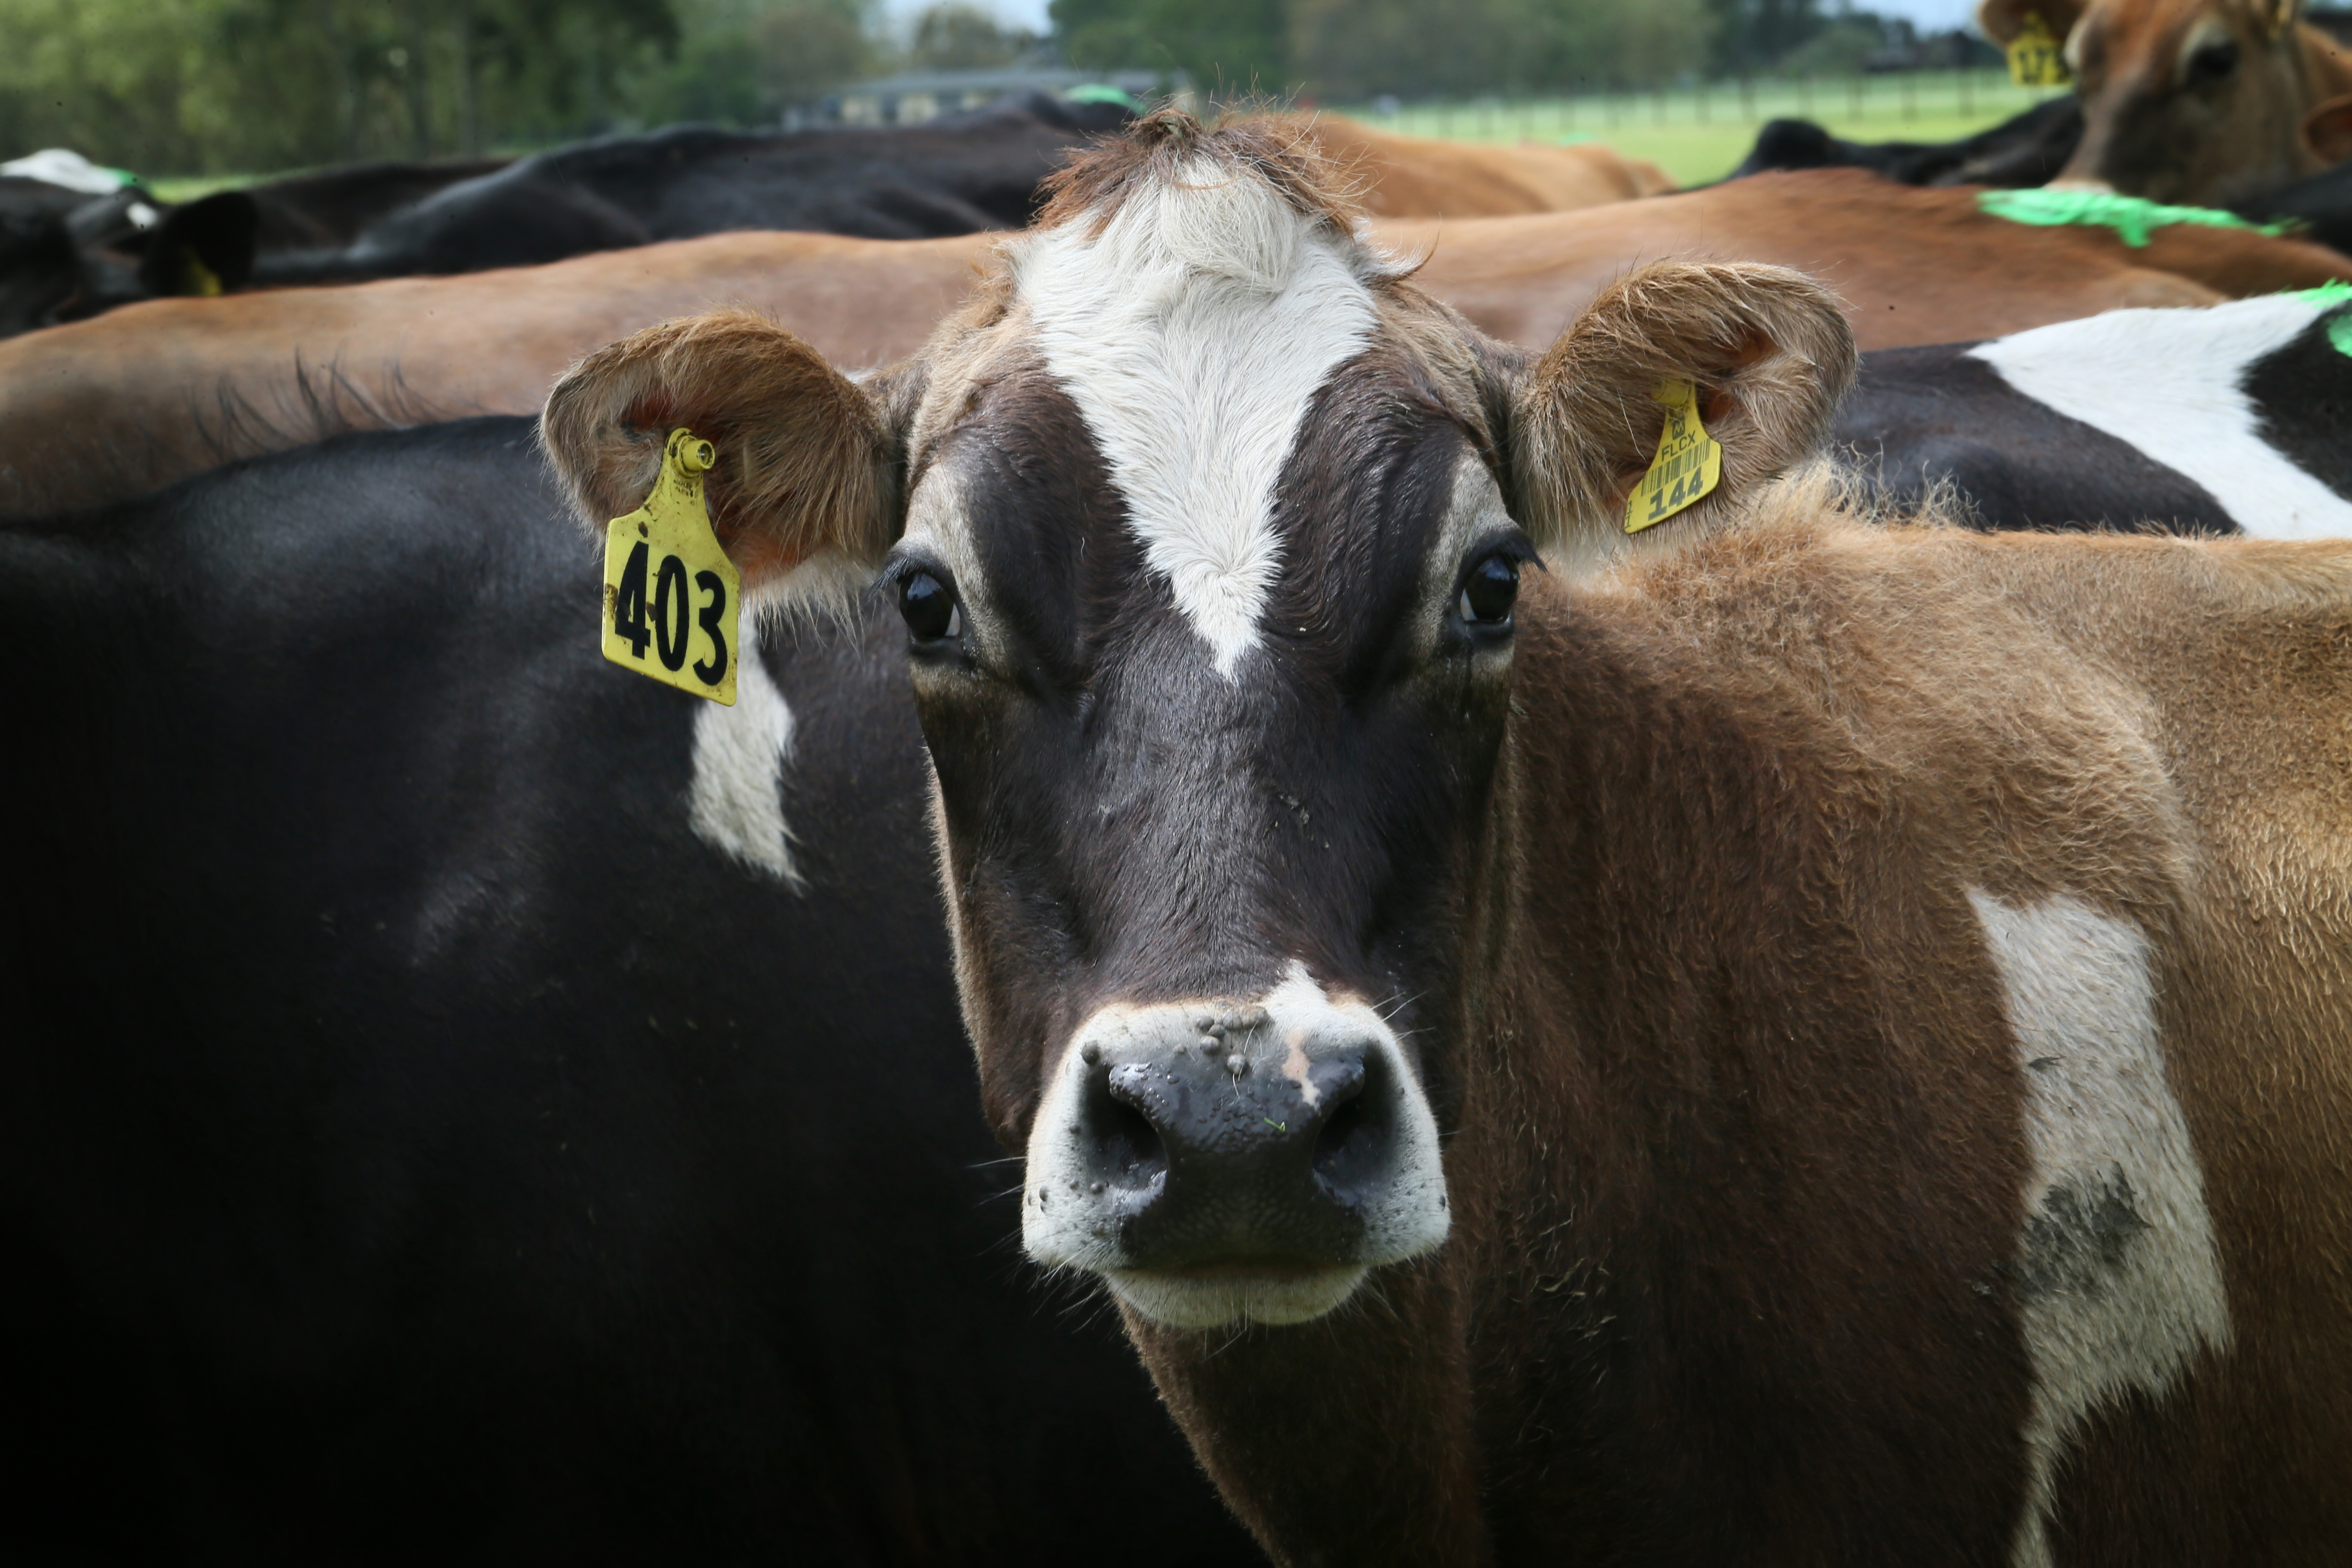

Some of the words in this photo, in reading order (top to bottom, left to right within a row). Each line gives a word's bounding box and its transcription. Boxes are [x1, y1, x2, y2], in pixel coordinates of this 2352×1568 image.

[1661, 430, 1696, 462] FLCX
[1647, 466, 1704, 521] 144
[614, 540, 728, 686] 403
